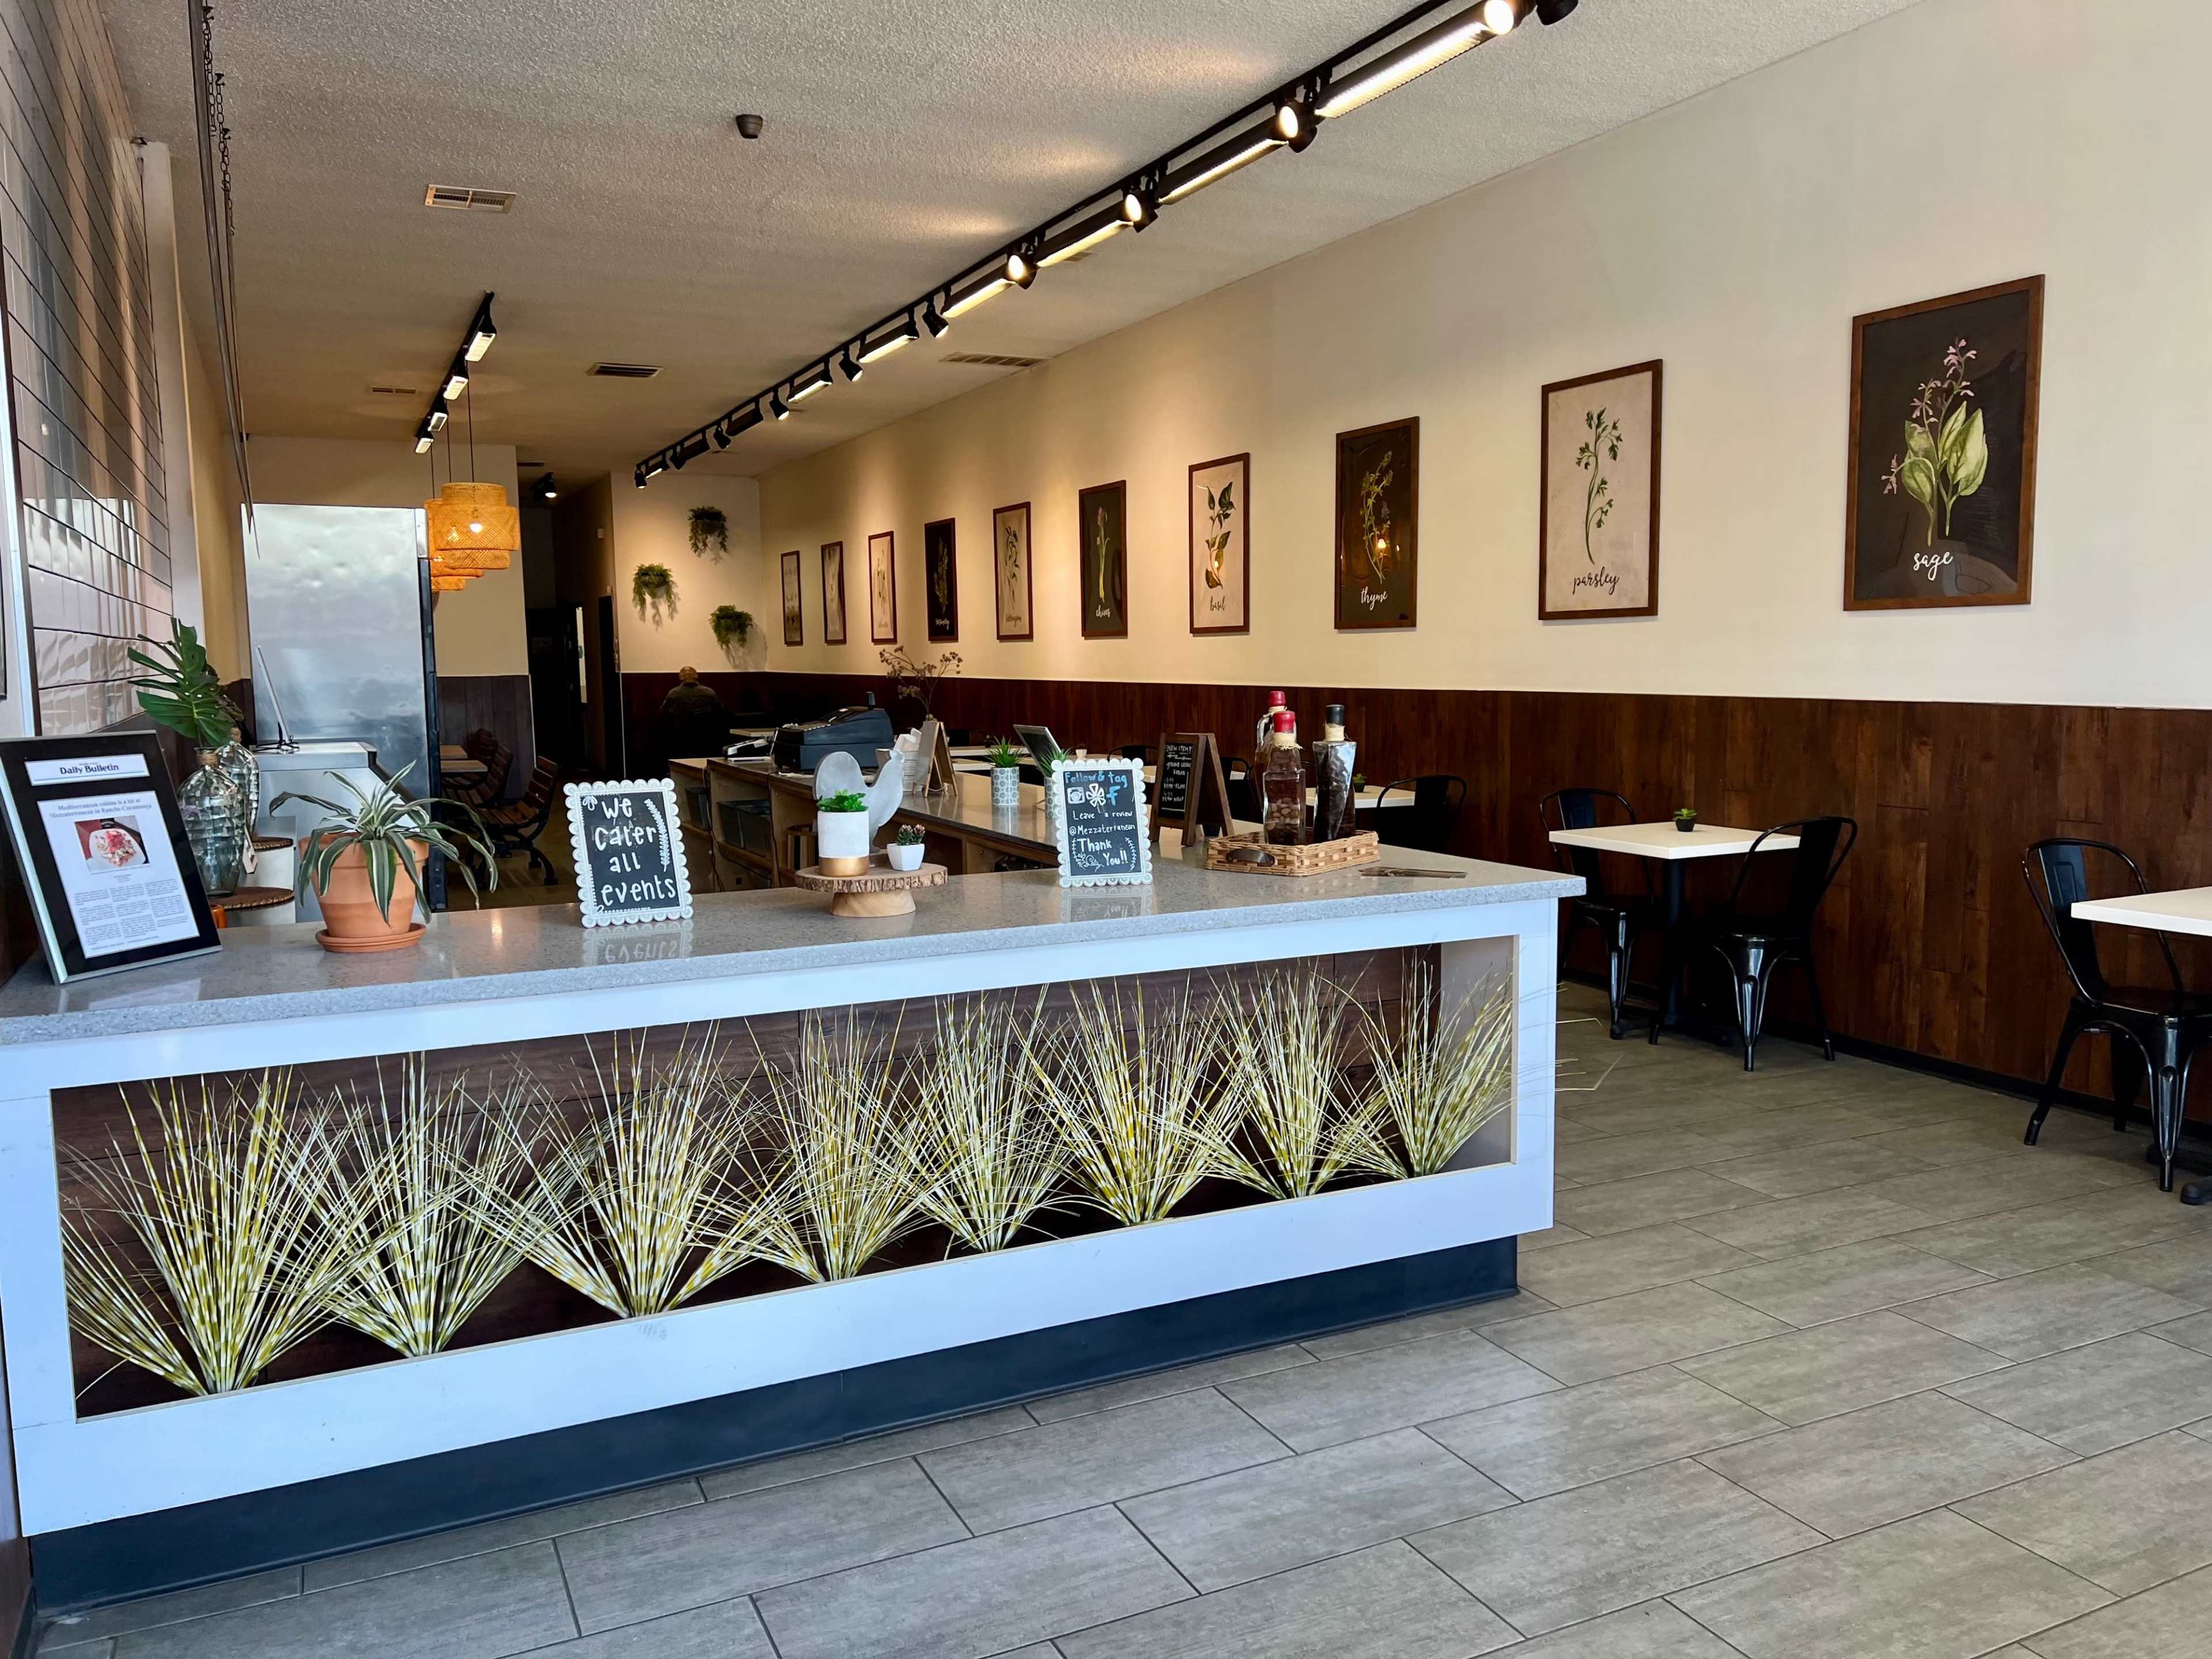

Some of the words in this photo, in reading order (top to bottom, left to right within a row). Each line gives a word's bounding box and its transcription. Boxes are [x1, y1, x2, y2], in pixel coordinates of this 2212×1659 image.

[1912, 551, 1953, 582] sage
[1573, 566, 1620, 595] parsley
[1209, 596, 1226, 611] basil
[1360, 586, 1388, 611] thyme
[59, 766, 83, 775] Daily
[85, 764, 119, 773] Bulletin
[1065, 771, 1097, 784] Follow
[1108, 772, 1128, 787] tag
[601, 797, 633, 819] We
[1073, 810, 1095, 821] Leave
[594, 825, 657, 851] Cater
[1069, 824, 1135, 836] @Mezzaterranean
[1077, 838, 1113, 853] Thank
[609, 852, 641, 874] all
[1102, 850, 1128, 866] You!!
[601, 874, 676, 907] events
